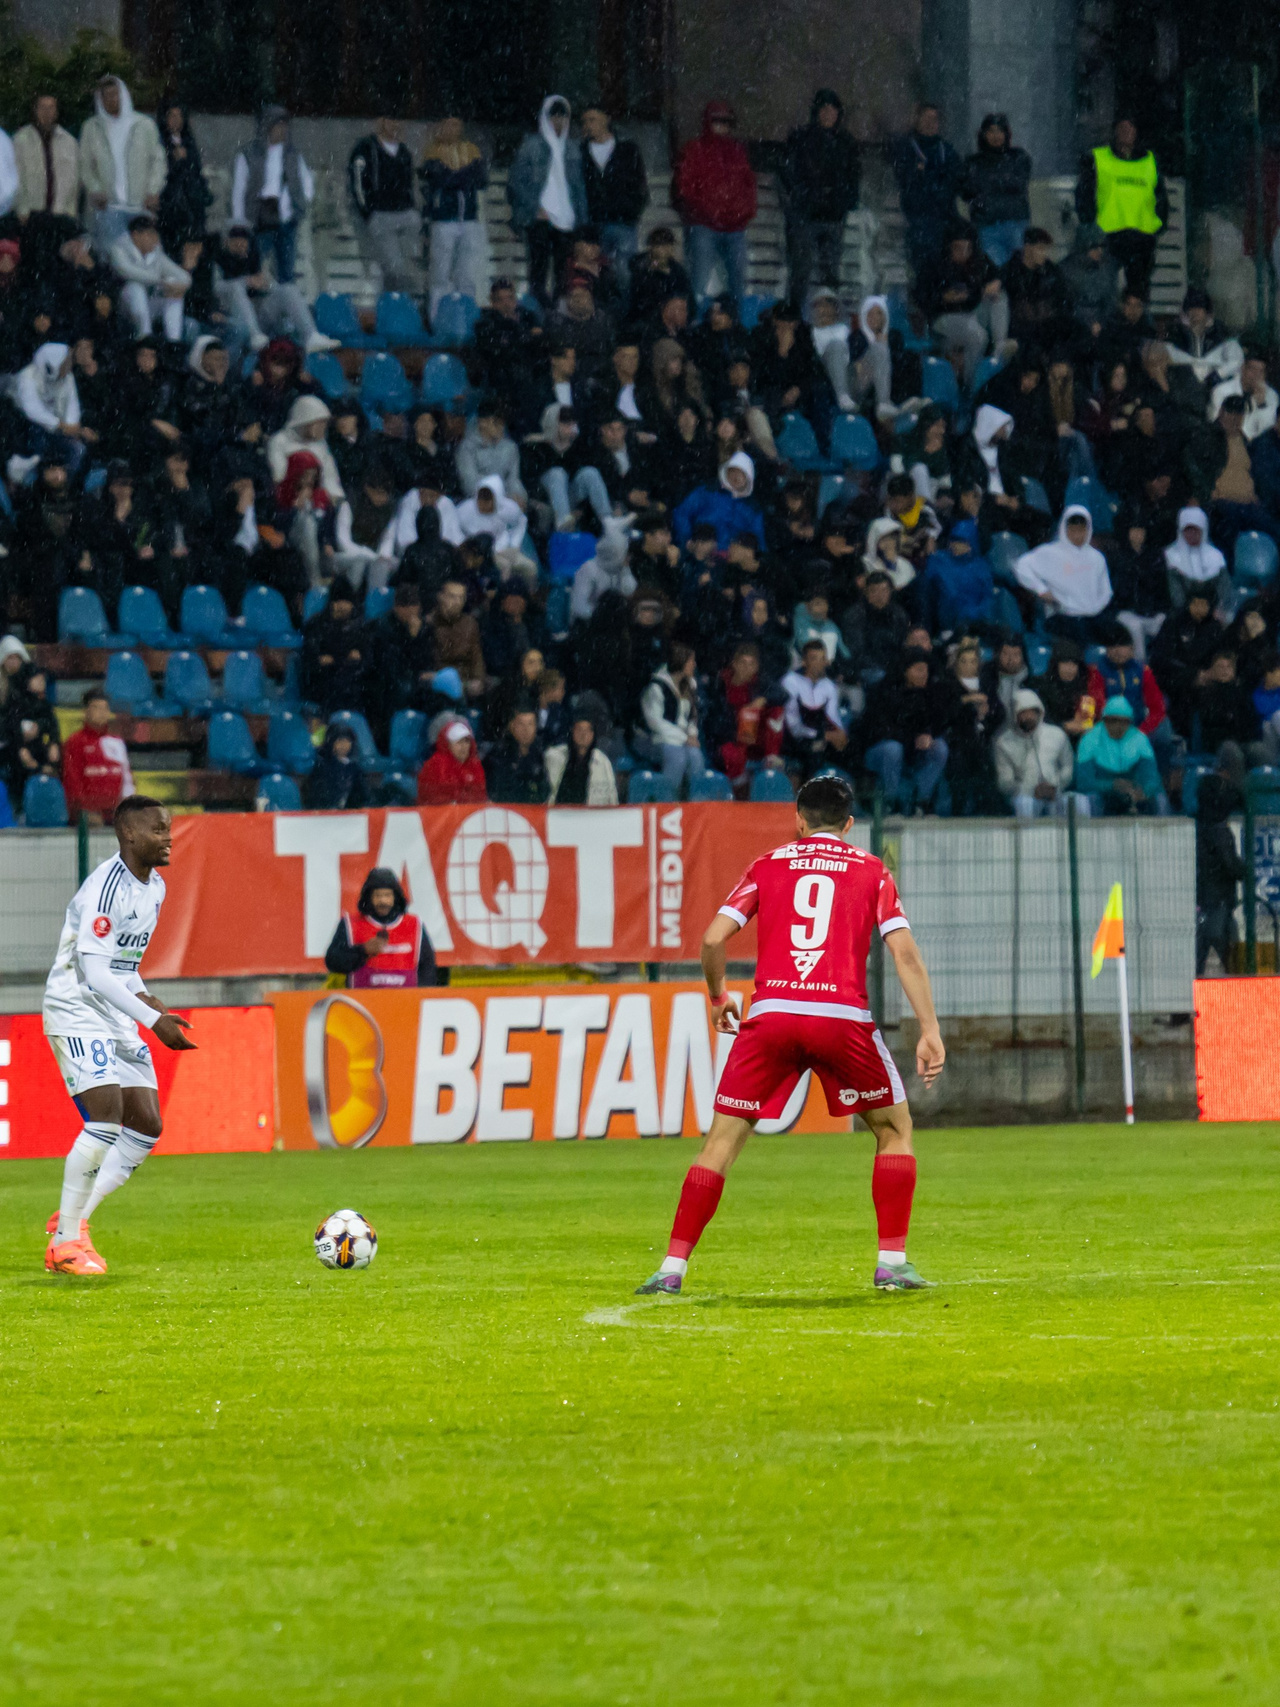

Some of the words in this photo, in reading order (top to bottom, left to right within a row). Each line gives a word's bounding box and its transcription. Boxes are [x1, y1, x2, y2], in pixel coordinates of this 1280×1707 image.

[274, 806, 644, 958] TAQT
[661, 807, 683, 948] MEDIA
[789, 858, 848, 873] SELMANI
[790, 874, 835, 950] 9
[790, 981, 837, 992] GAMING
[410, 991, 810, 1144] BETAN
[717, 1093, 760, 1111] CARPATINA
